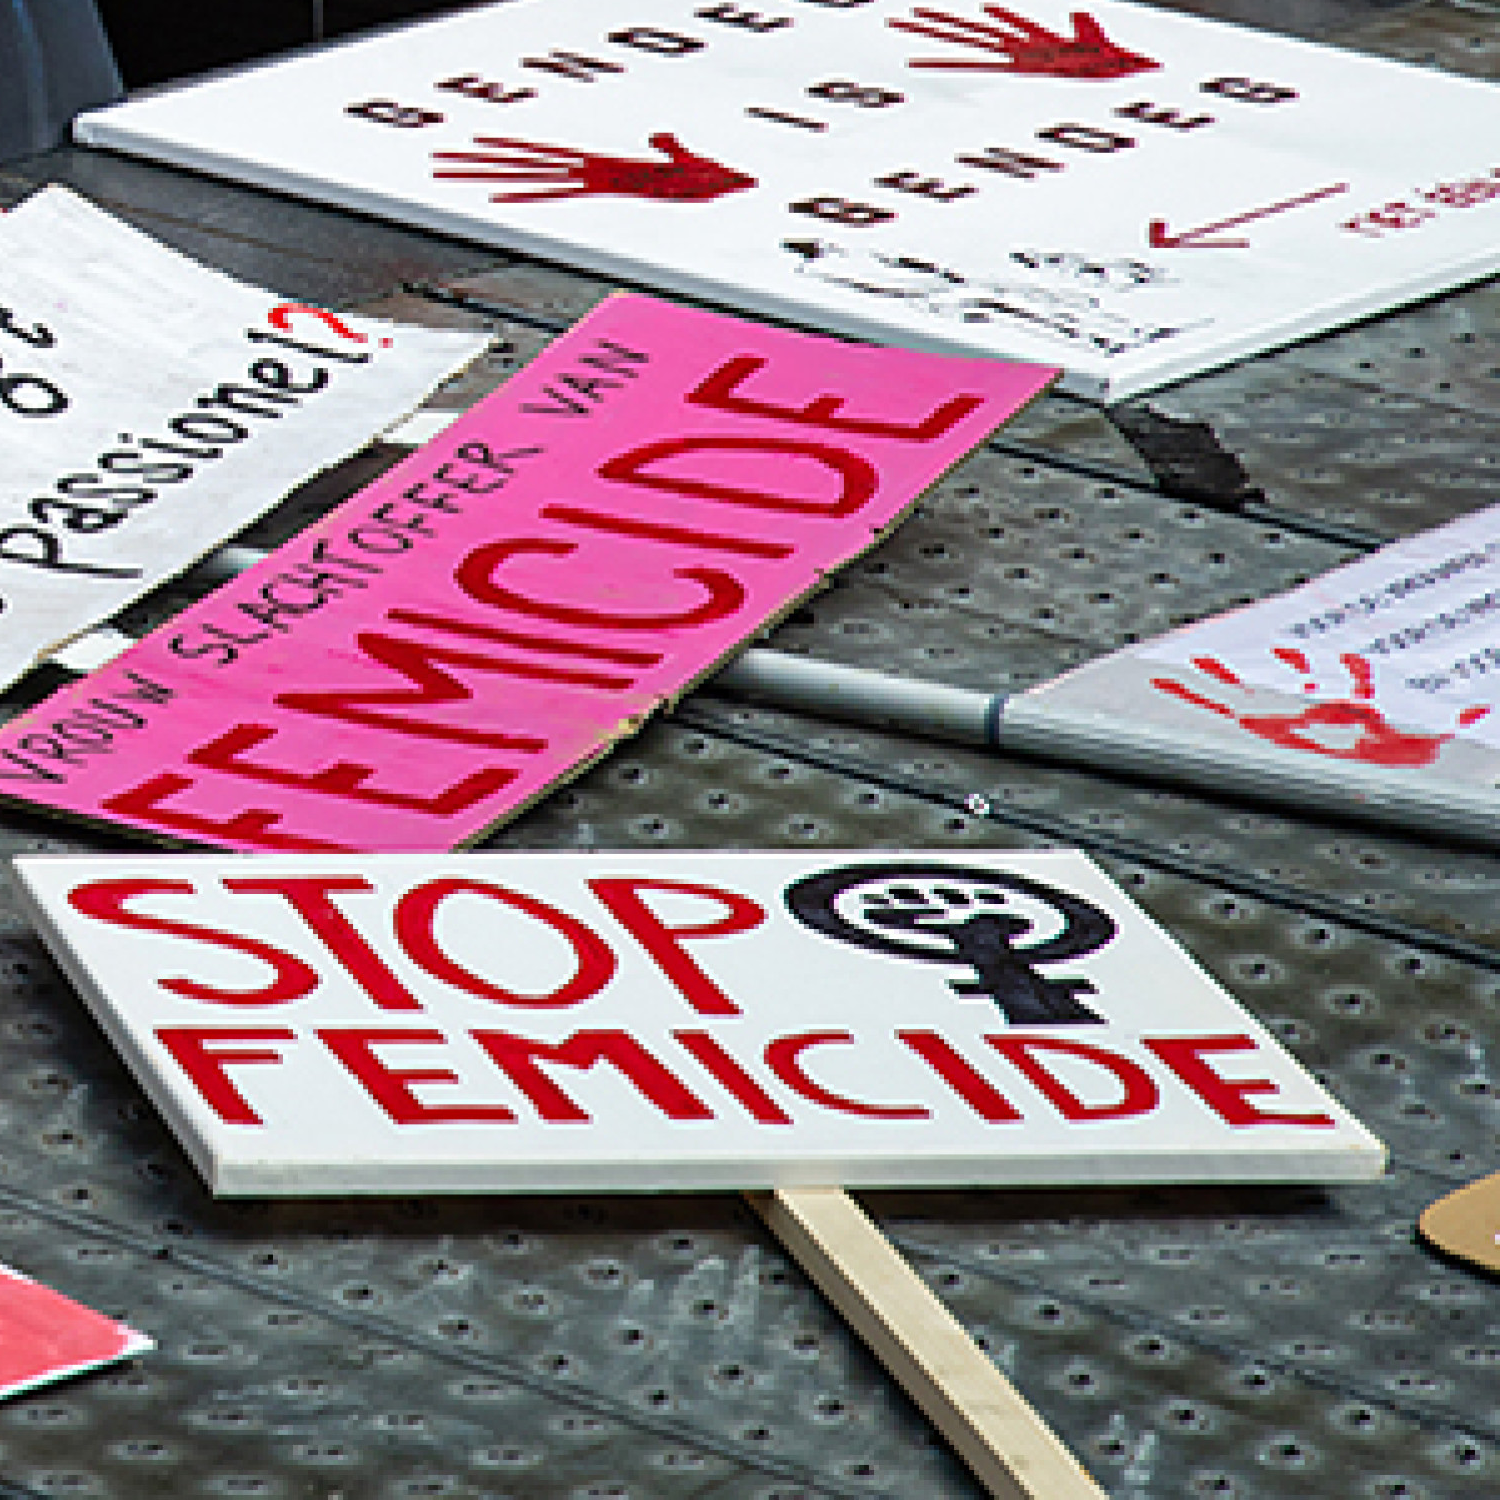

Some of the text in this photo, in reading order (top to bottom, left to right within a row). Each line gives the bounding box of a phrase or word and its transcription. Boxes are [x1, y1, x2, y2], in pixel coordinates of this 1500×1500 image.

[101, 356, 987, 854] FEMICIDE
[168, 438, 542, 666] SLACHTOFFER
[522, 340, 650, 418] VAN
[66, 876, 770, 1016] STOP
[154, 1027, 1338, 1128] FEMICIDE
